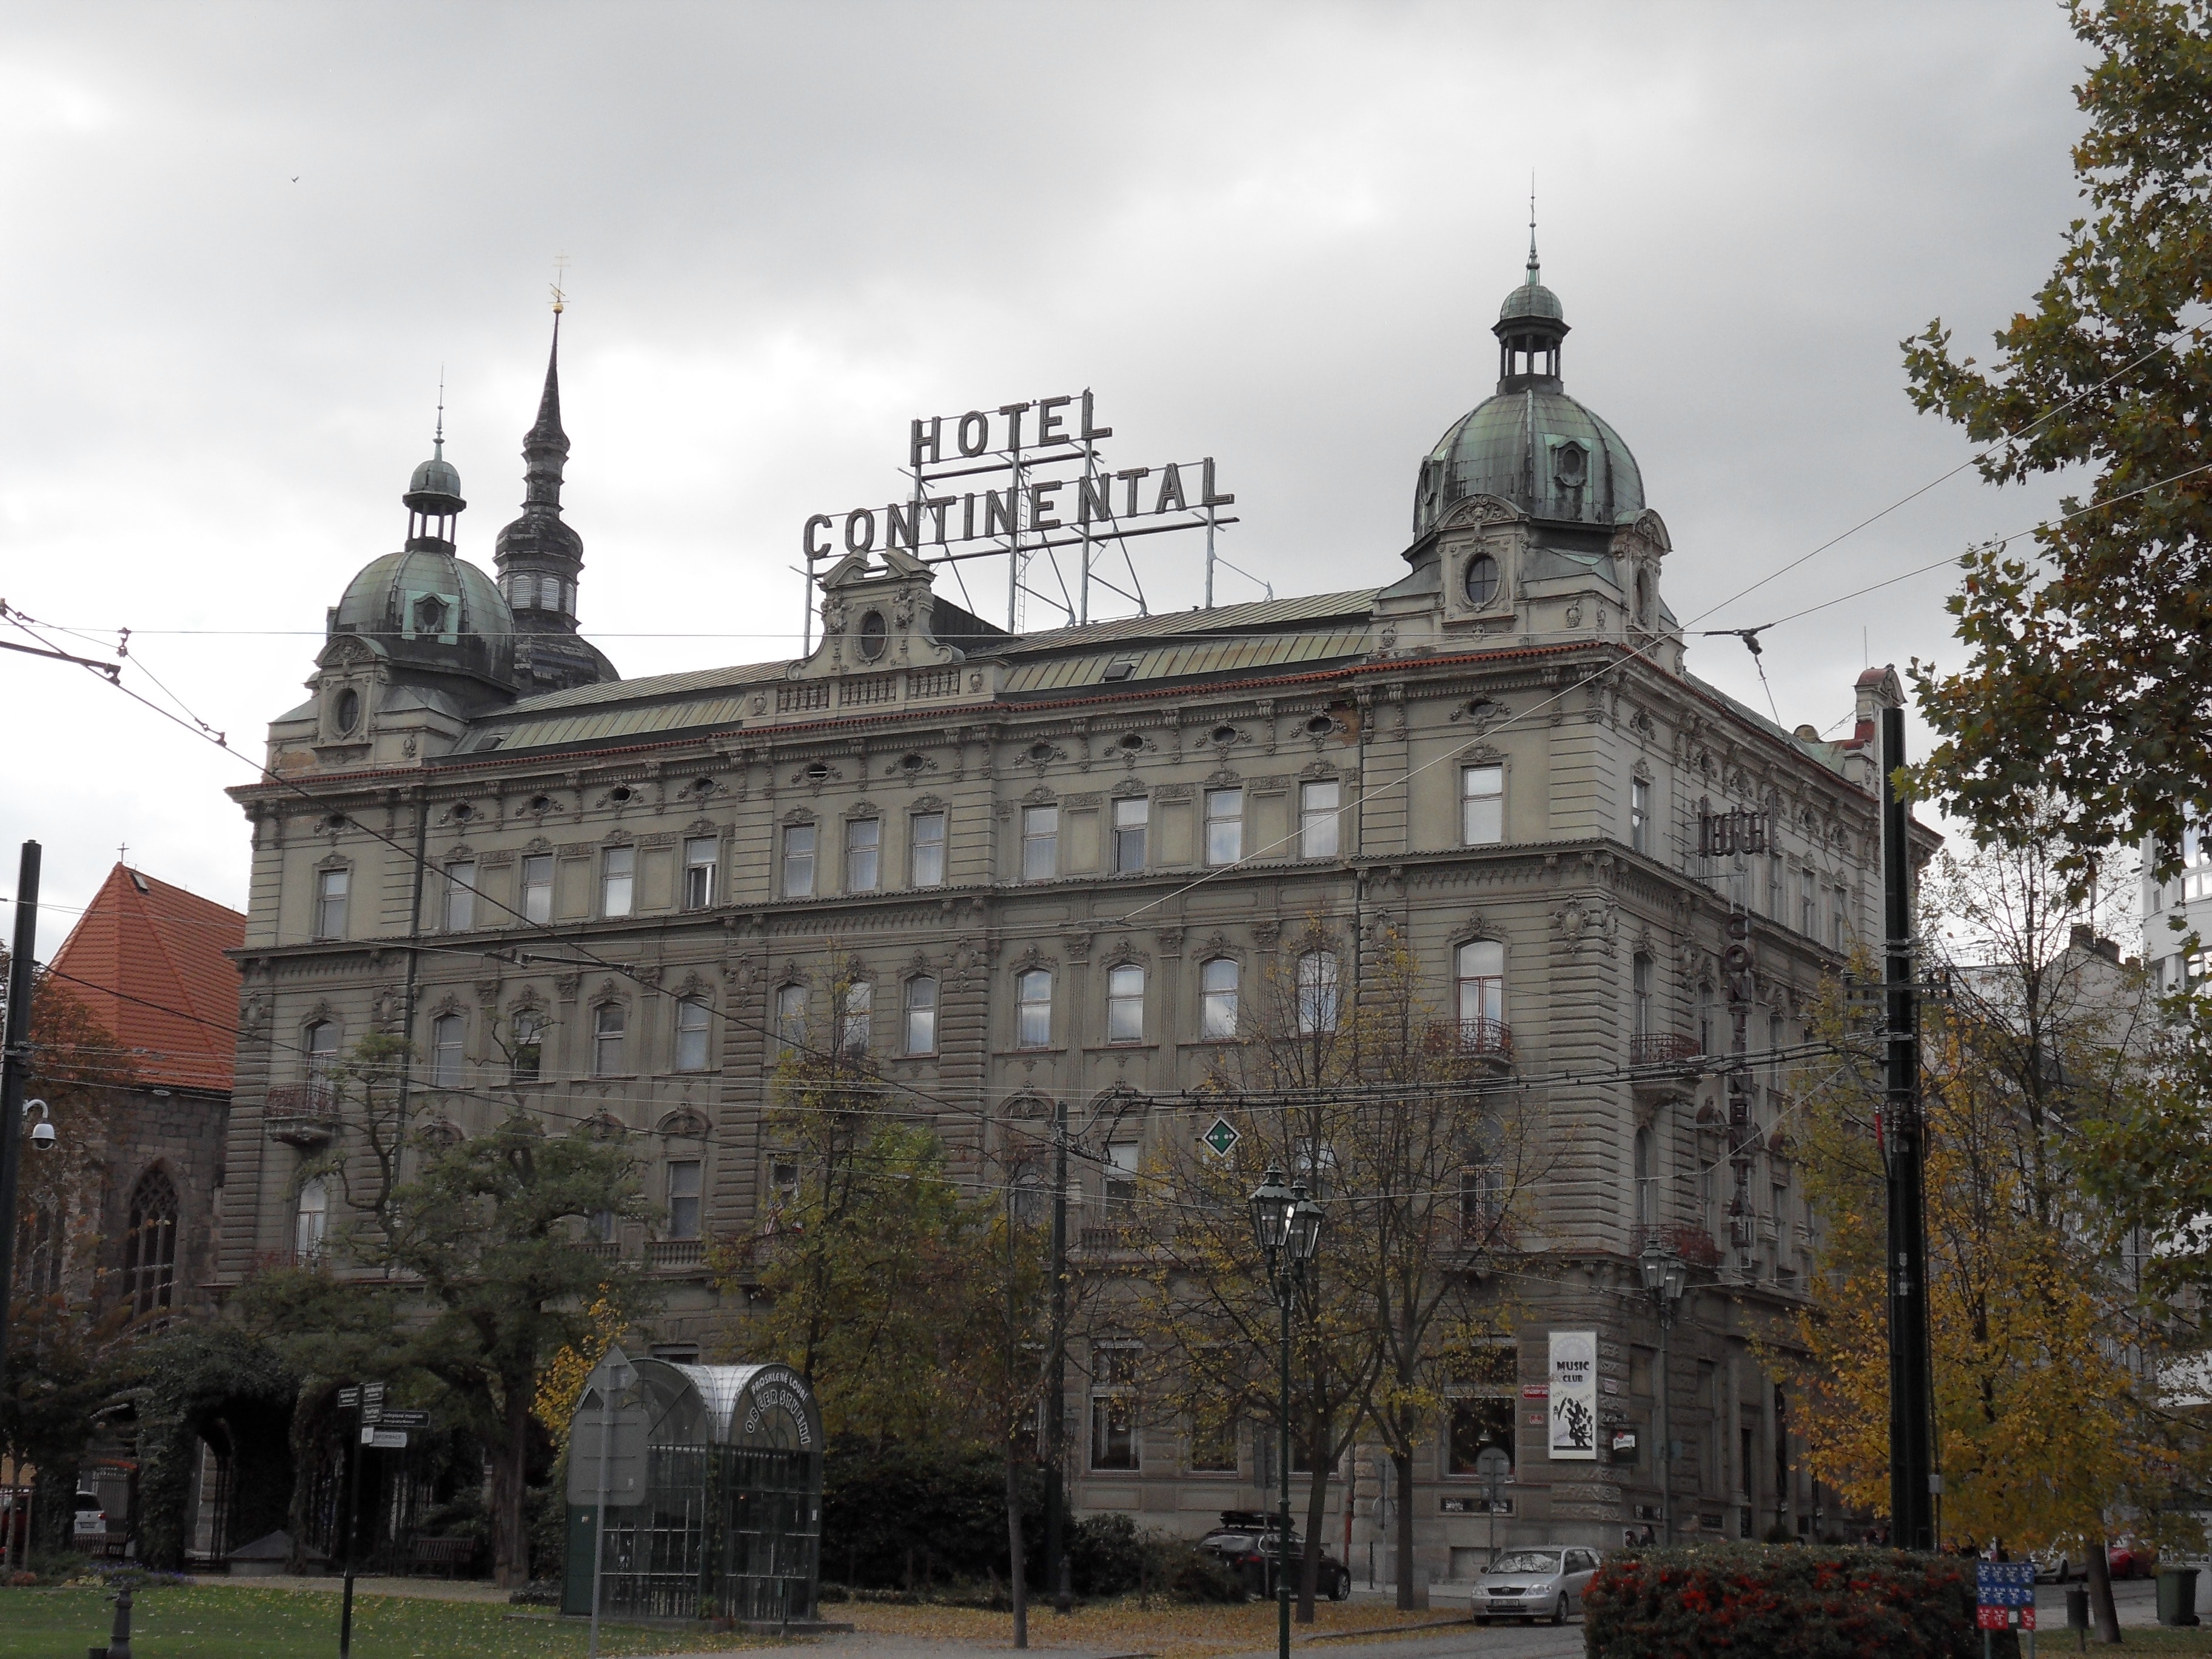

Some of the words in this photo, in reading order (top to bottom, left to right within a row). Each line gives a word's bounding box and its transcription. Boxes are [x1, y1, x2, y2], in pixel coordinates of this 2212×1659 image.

[910, 391, 1112, 466] HOTEL
[803, 457, 1235, 559] CONTINENTAL
[1557, 1361, 1590, 1371] MUSIC
